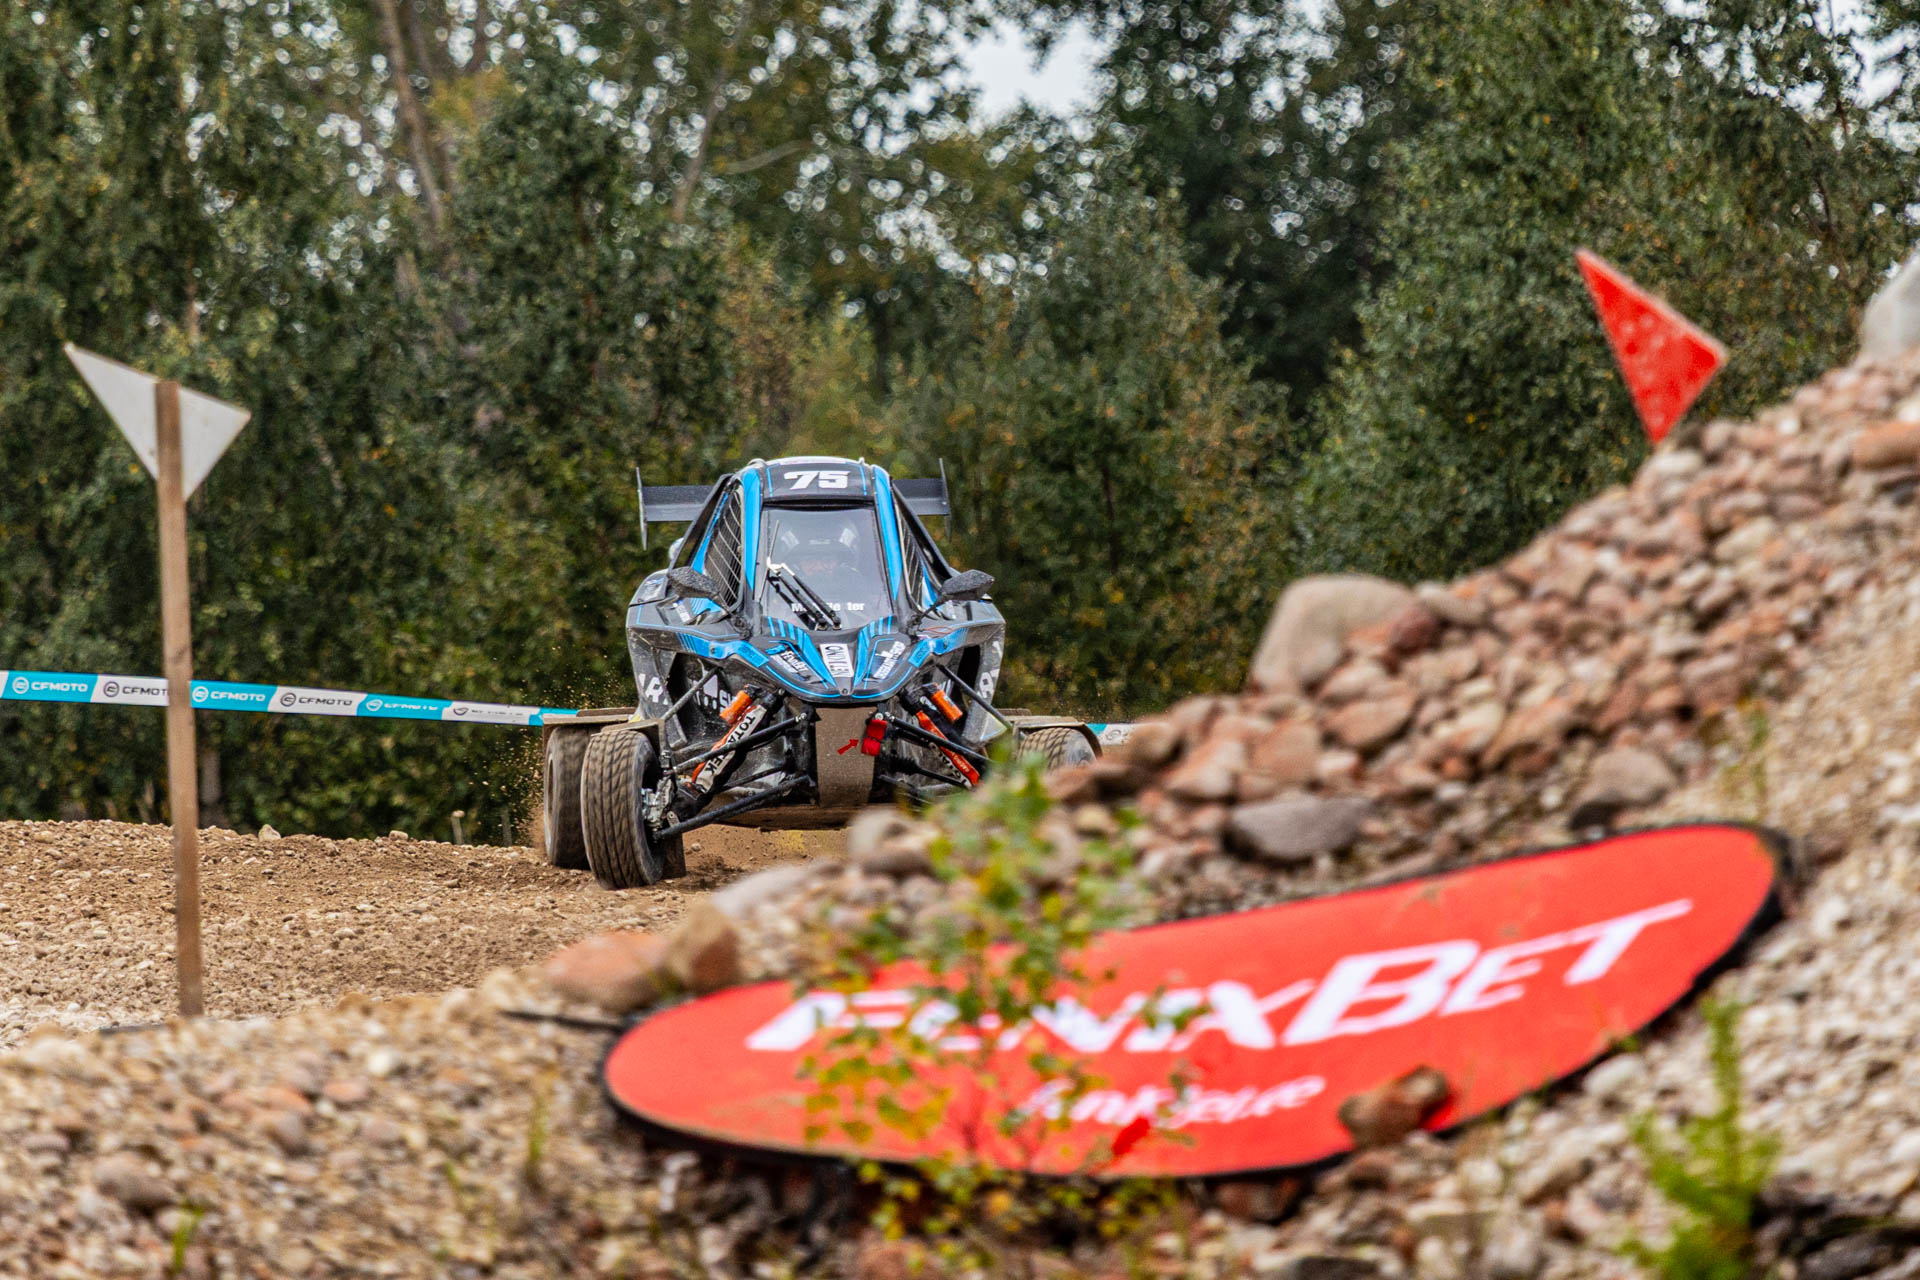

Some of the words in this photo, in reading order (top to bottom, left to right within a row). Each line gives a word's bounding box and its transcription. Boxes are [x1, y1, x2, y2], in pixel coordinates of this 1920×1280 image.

[784, 470, 851, 490] 75
[31, 682, 88, 692] CFMOTO
[122, 686, 169, 696] CFMOT
[210, 690, 266, 702] CFMOTO
[298, 696, 353, 706] CFMOTO
